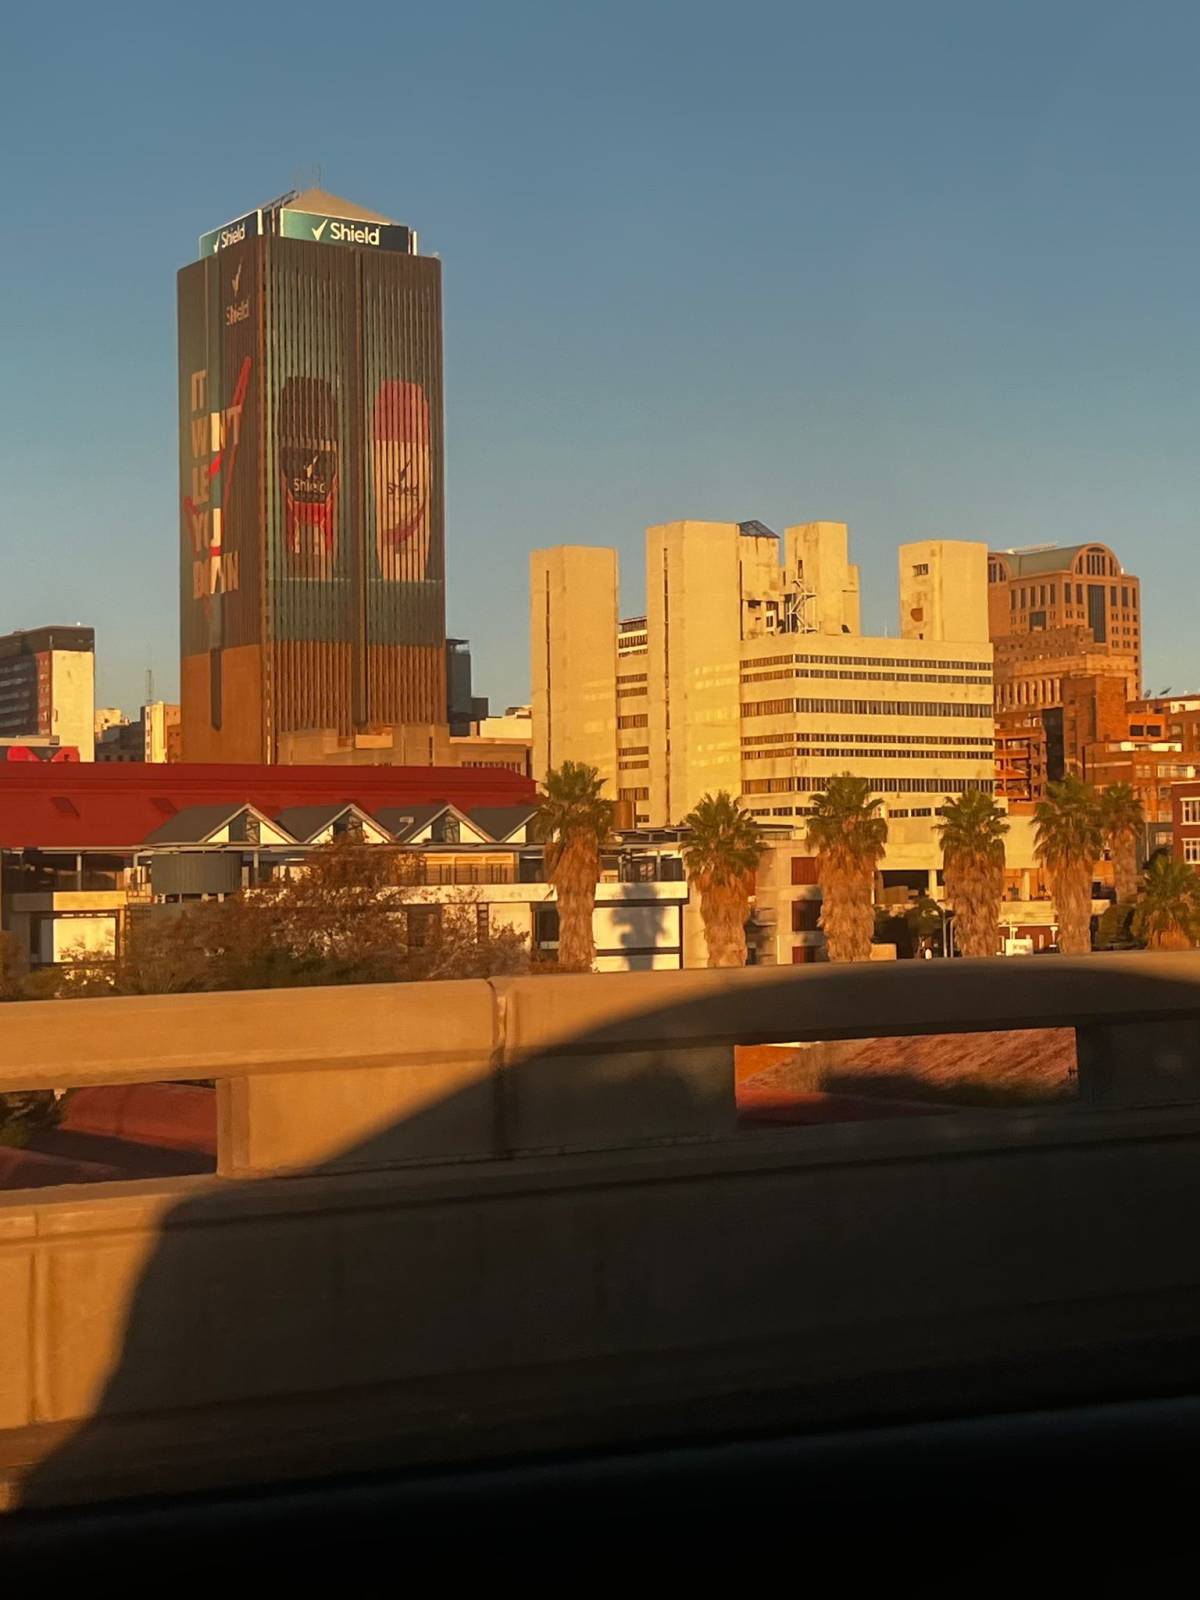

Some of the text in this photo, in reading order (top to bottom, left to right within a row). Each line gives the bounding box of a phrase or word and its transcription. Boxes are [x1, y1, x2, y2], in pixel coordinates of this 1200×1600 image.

[221, 221, 246, 248] Shield
[330, 222, 380, 246] Shield
[226, 298, 249, 325] Shield
[293, 478, 326, 494] Shied
[388, 481, 418, 496] Shied
